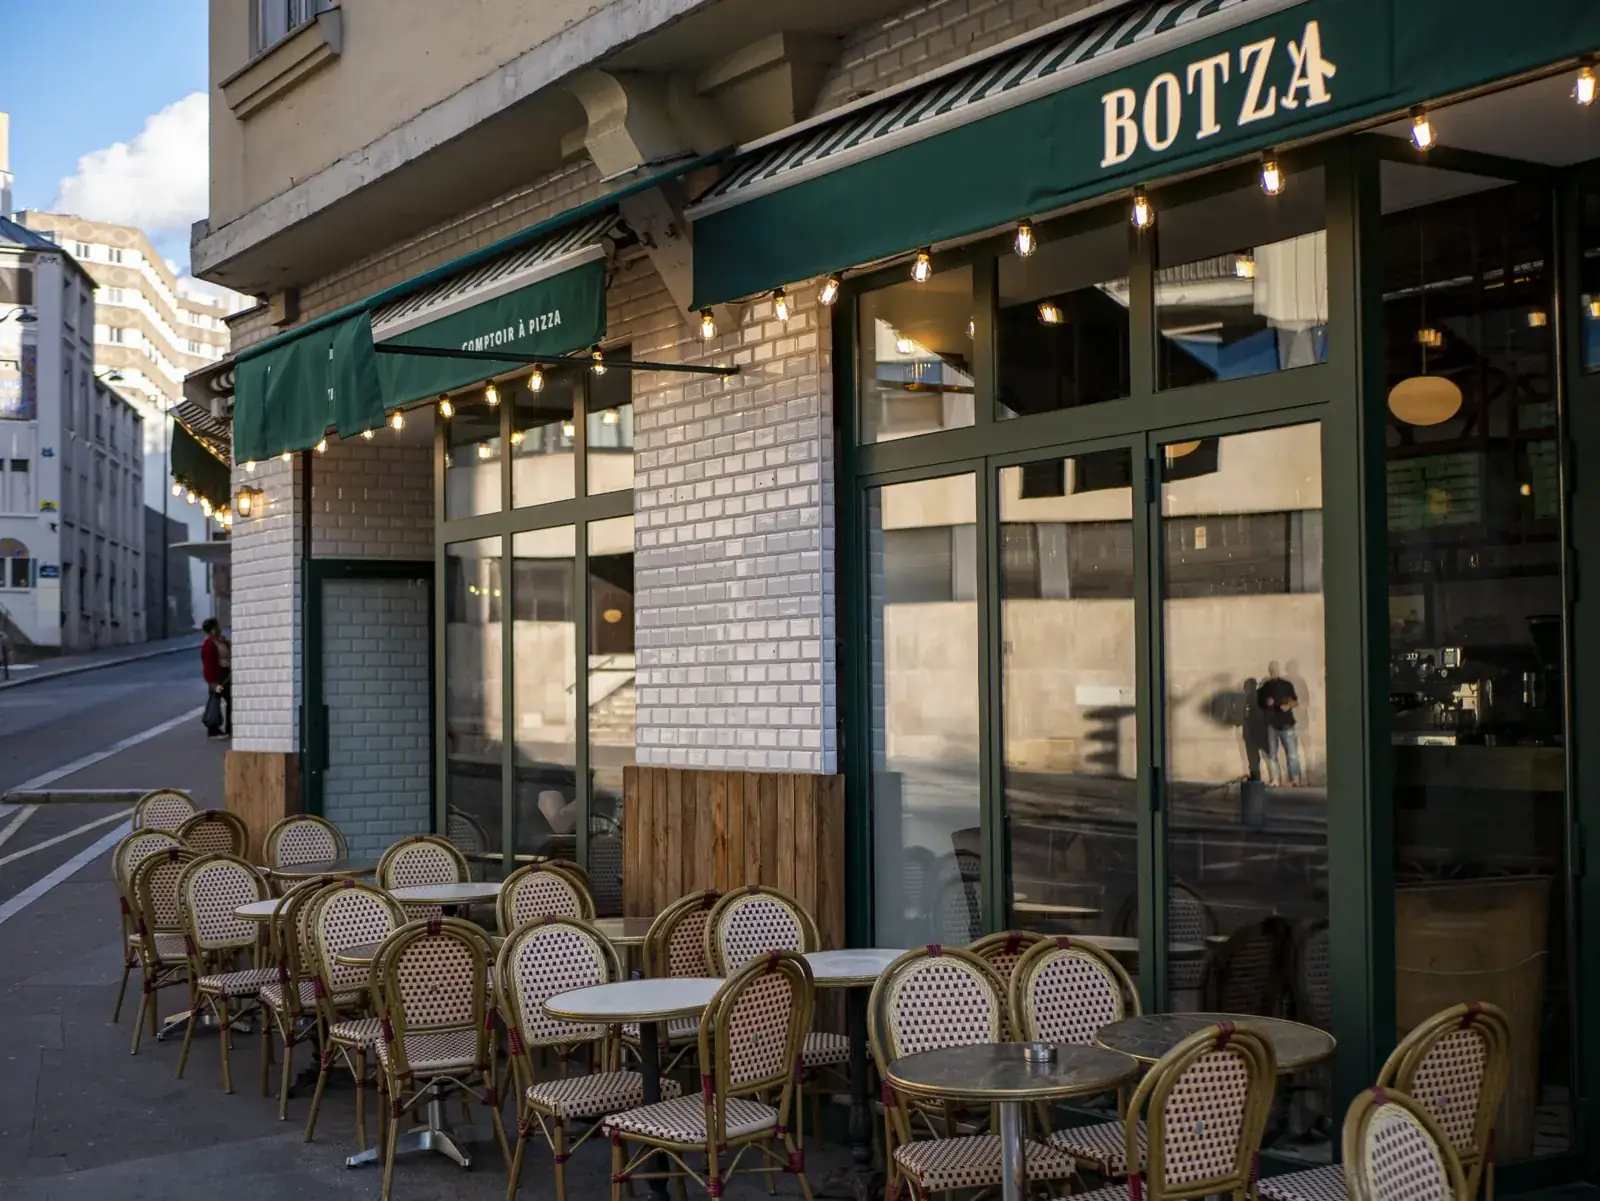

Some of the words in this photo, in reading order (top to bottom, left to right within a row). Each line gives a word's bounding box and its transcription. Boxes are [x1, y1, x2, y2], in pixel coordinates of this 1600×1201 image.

[1101, 20, 1336, 168] BOTZA
[518, 319, 526, 338] À
[529, 310, 561, 335] PIZZA
